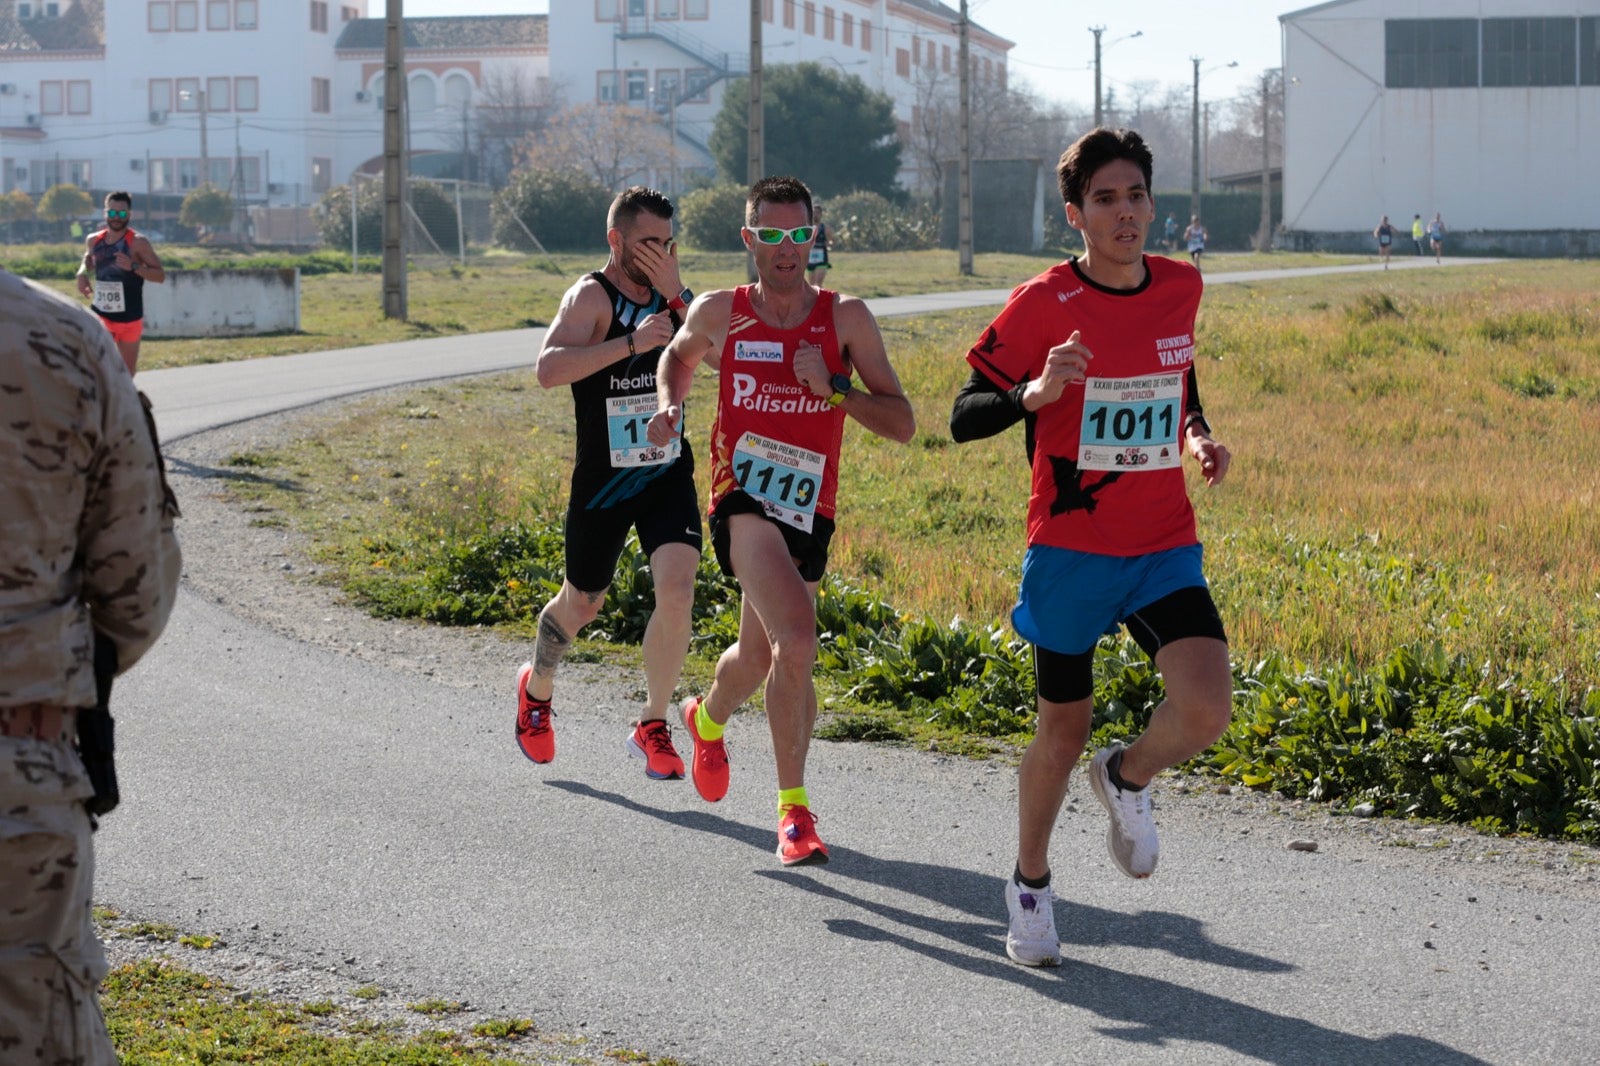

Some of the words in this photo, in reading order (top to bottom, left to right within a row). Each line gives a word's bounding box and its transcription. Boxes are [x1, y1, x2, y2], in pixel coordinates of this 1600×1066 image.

[1156, 334, 1190, 350] RUNNING
[1113, 380, 1130, 390] GRAN
[1131, 379, 1153, 389] PREMIO
[1153, 378, 1160, 388] DE
[1160, 376, 1179, 386] FONDO
[627, 396, 641, 405] GRAN
[1089, 404, 1173, 440] 1011
[761, 439, 780, 451] GRAN
[778, 445, 800, 458] PREMIO
[799, 450, 808, 461] DE
[806, 453, 821, 465] FONDO
[736, 459, 816, 507] 1119
